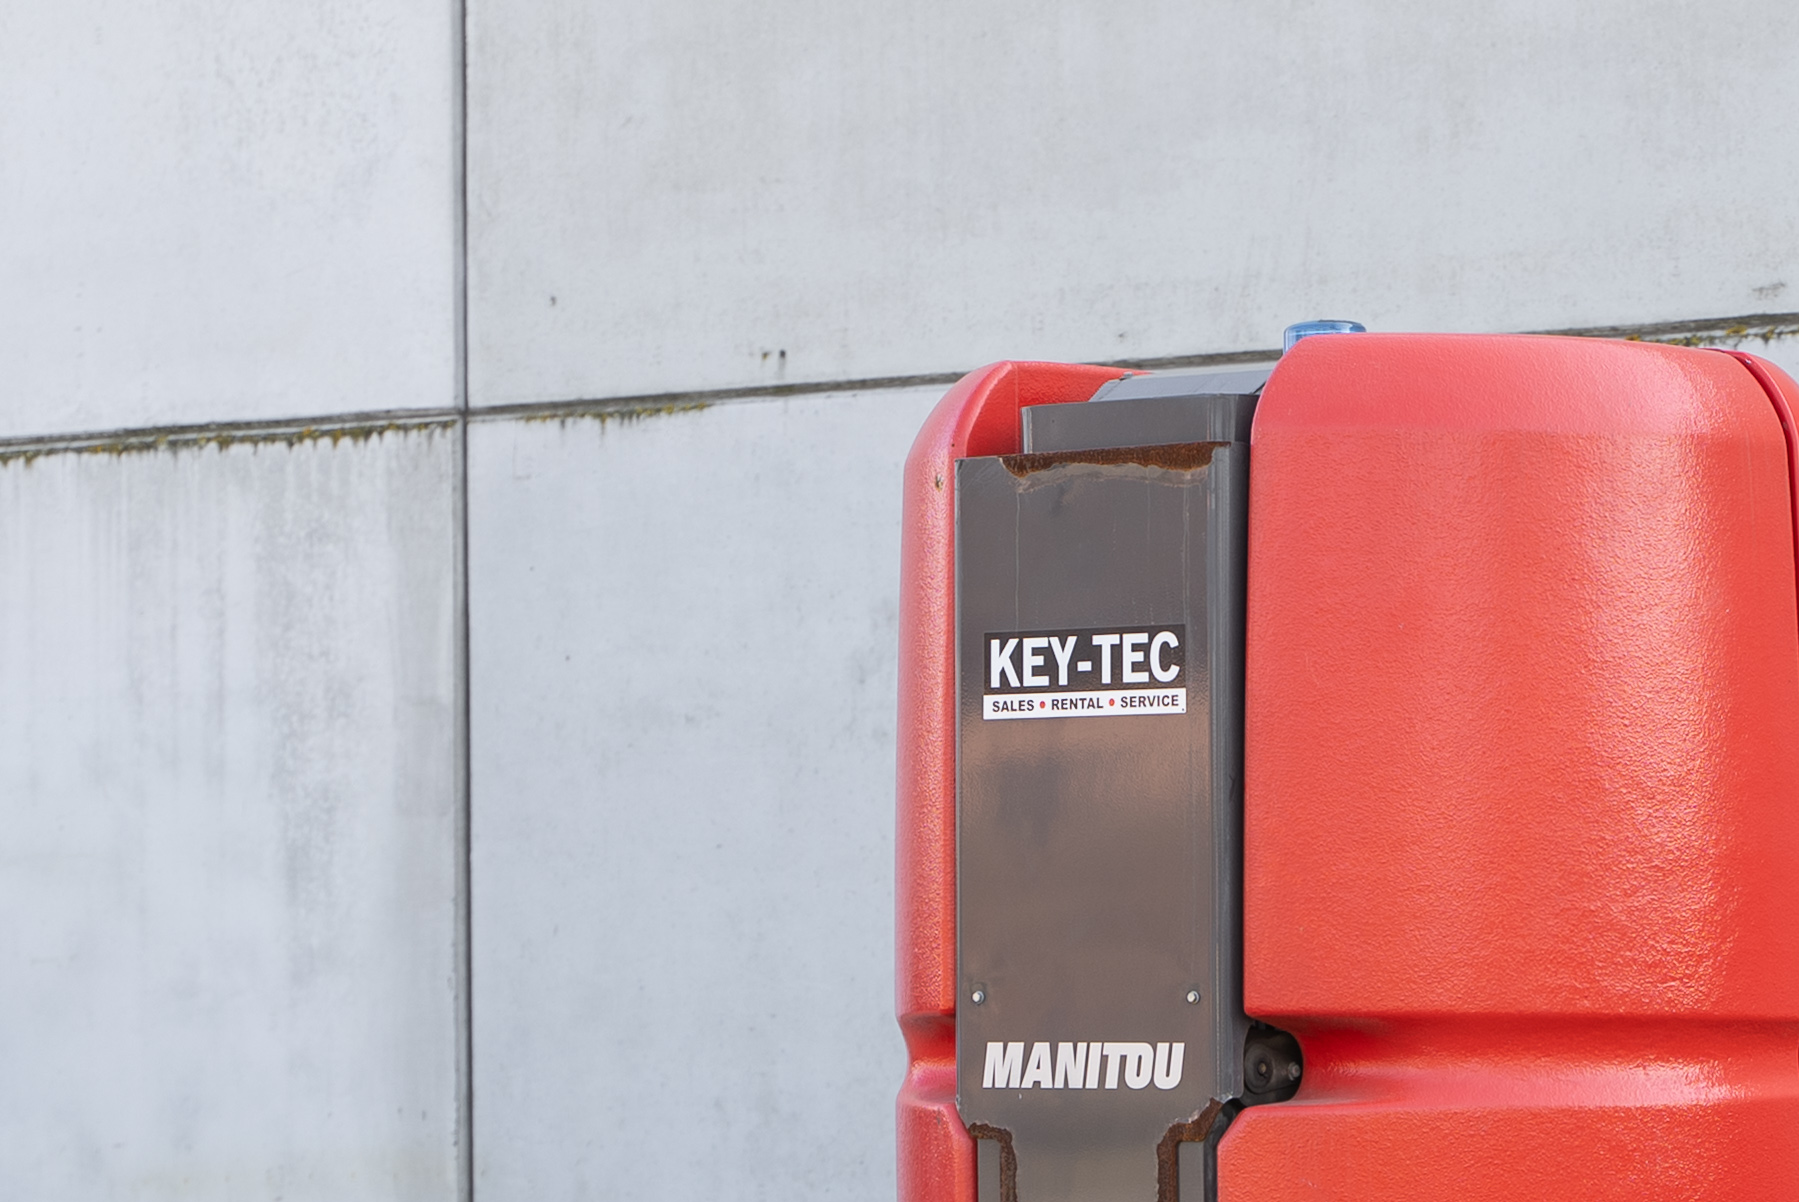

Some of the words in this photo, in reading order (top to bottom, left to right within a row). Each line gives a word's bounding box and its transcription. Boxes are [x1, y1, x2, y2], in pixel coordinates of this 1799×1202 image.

[990, 630, 1181, 689] KEY-TEC
[992, 699, 1035, 713] SALES
[1051, 697, 1104, 711] RENTAL
[1120, 694, 1179, 709] SERVICE
[982, 1041, 1185, 1090] MANITOU
